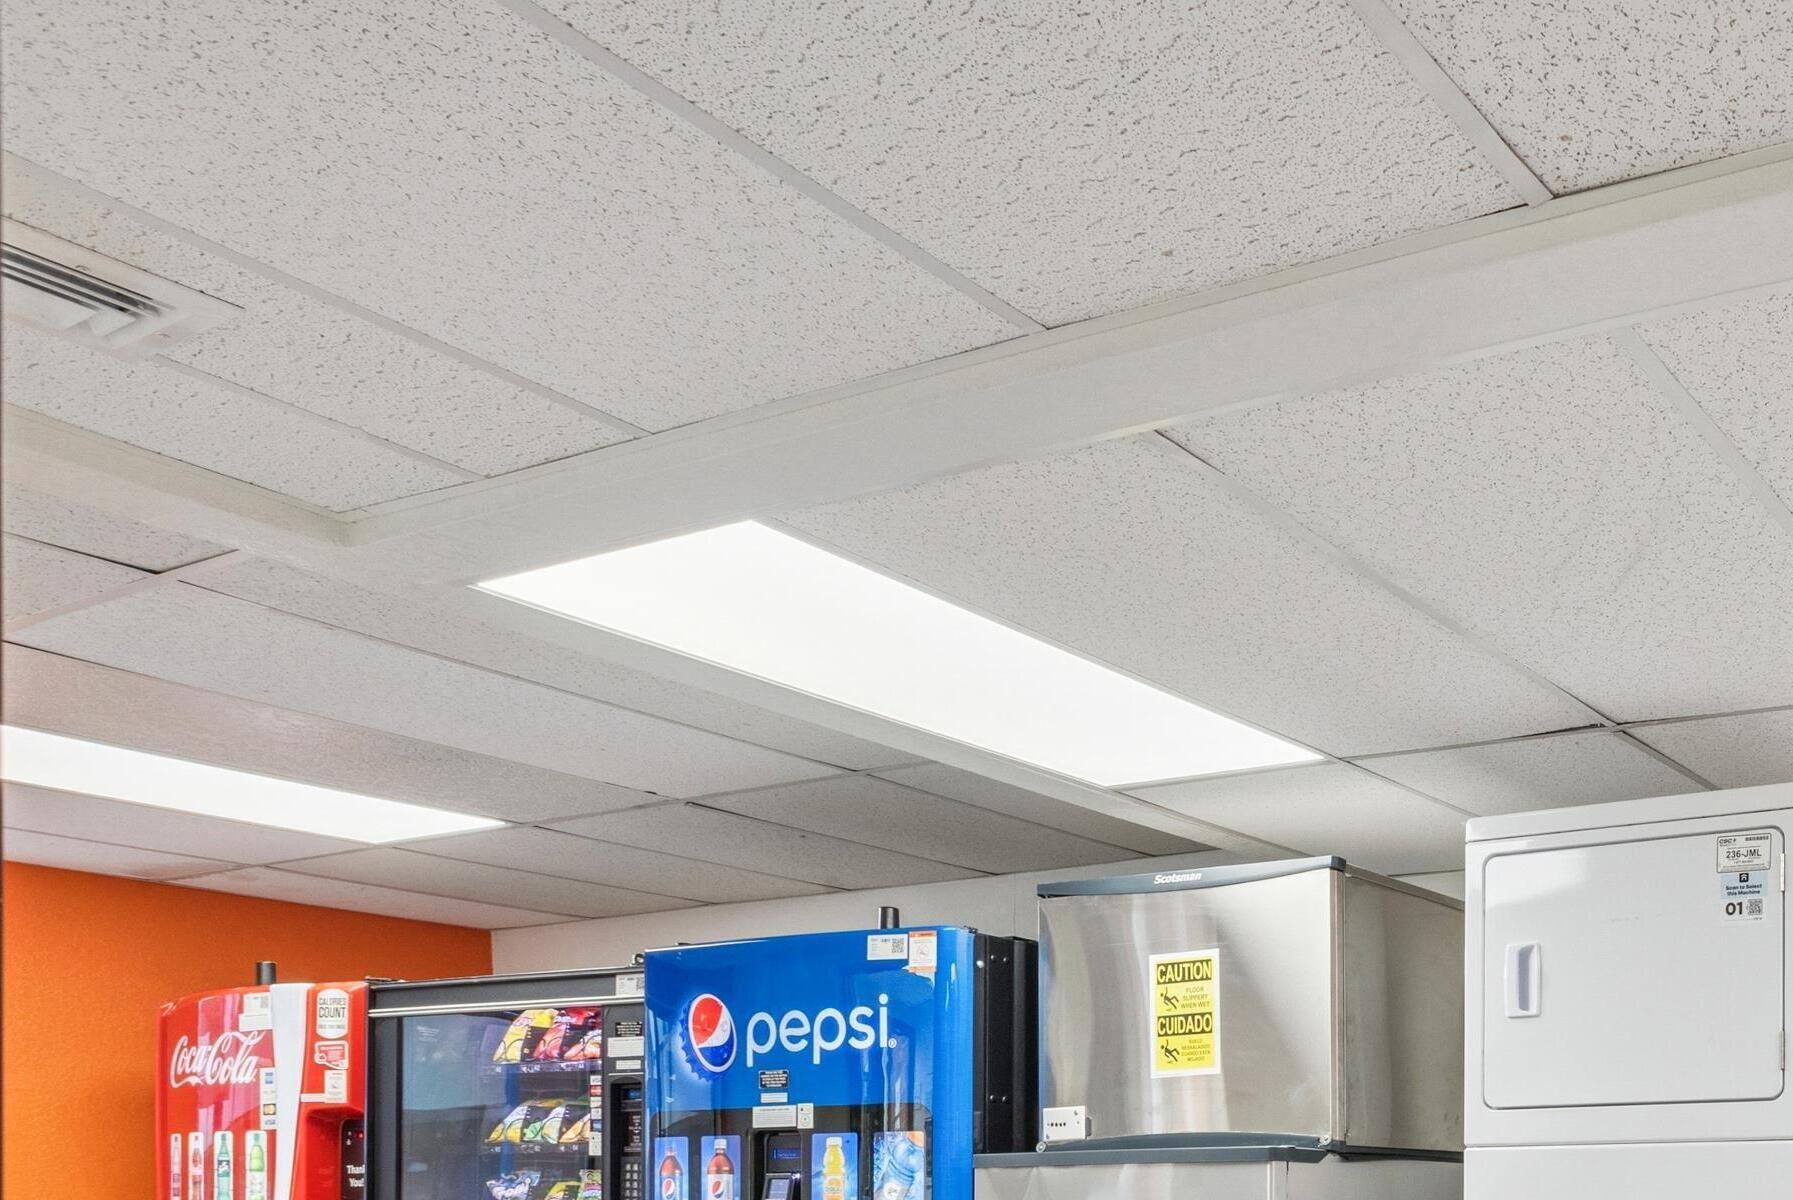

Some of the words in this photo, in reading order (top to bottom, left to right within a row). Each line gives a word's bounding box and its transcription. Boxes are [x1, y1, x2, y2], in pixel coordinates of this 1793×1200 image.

[1726, 848, 1762, 859] 236-JML
[1153, 872, 1202, 884] Scotsman
[1725, 901, 1743, 916] 01
[1157, 960, 1212, 983] CAUTION
[318, 1006, 346, 1018] COUNT
[746, 993, 889, 1067] pepsi
[1158, 1013, 1212, 1036] CUIDADO
[170, 1031, 265, 1088] Coca-Cola
